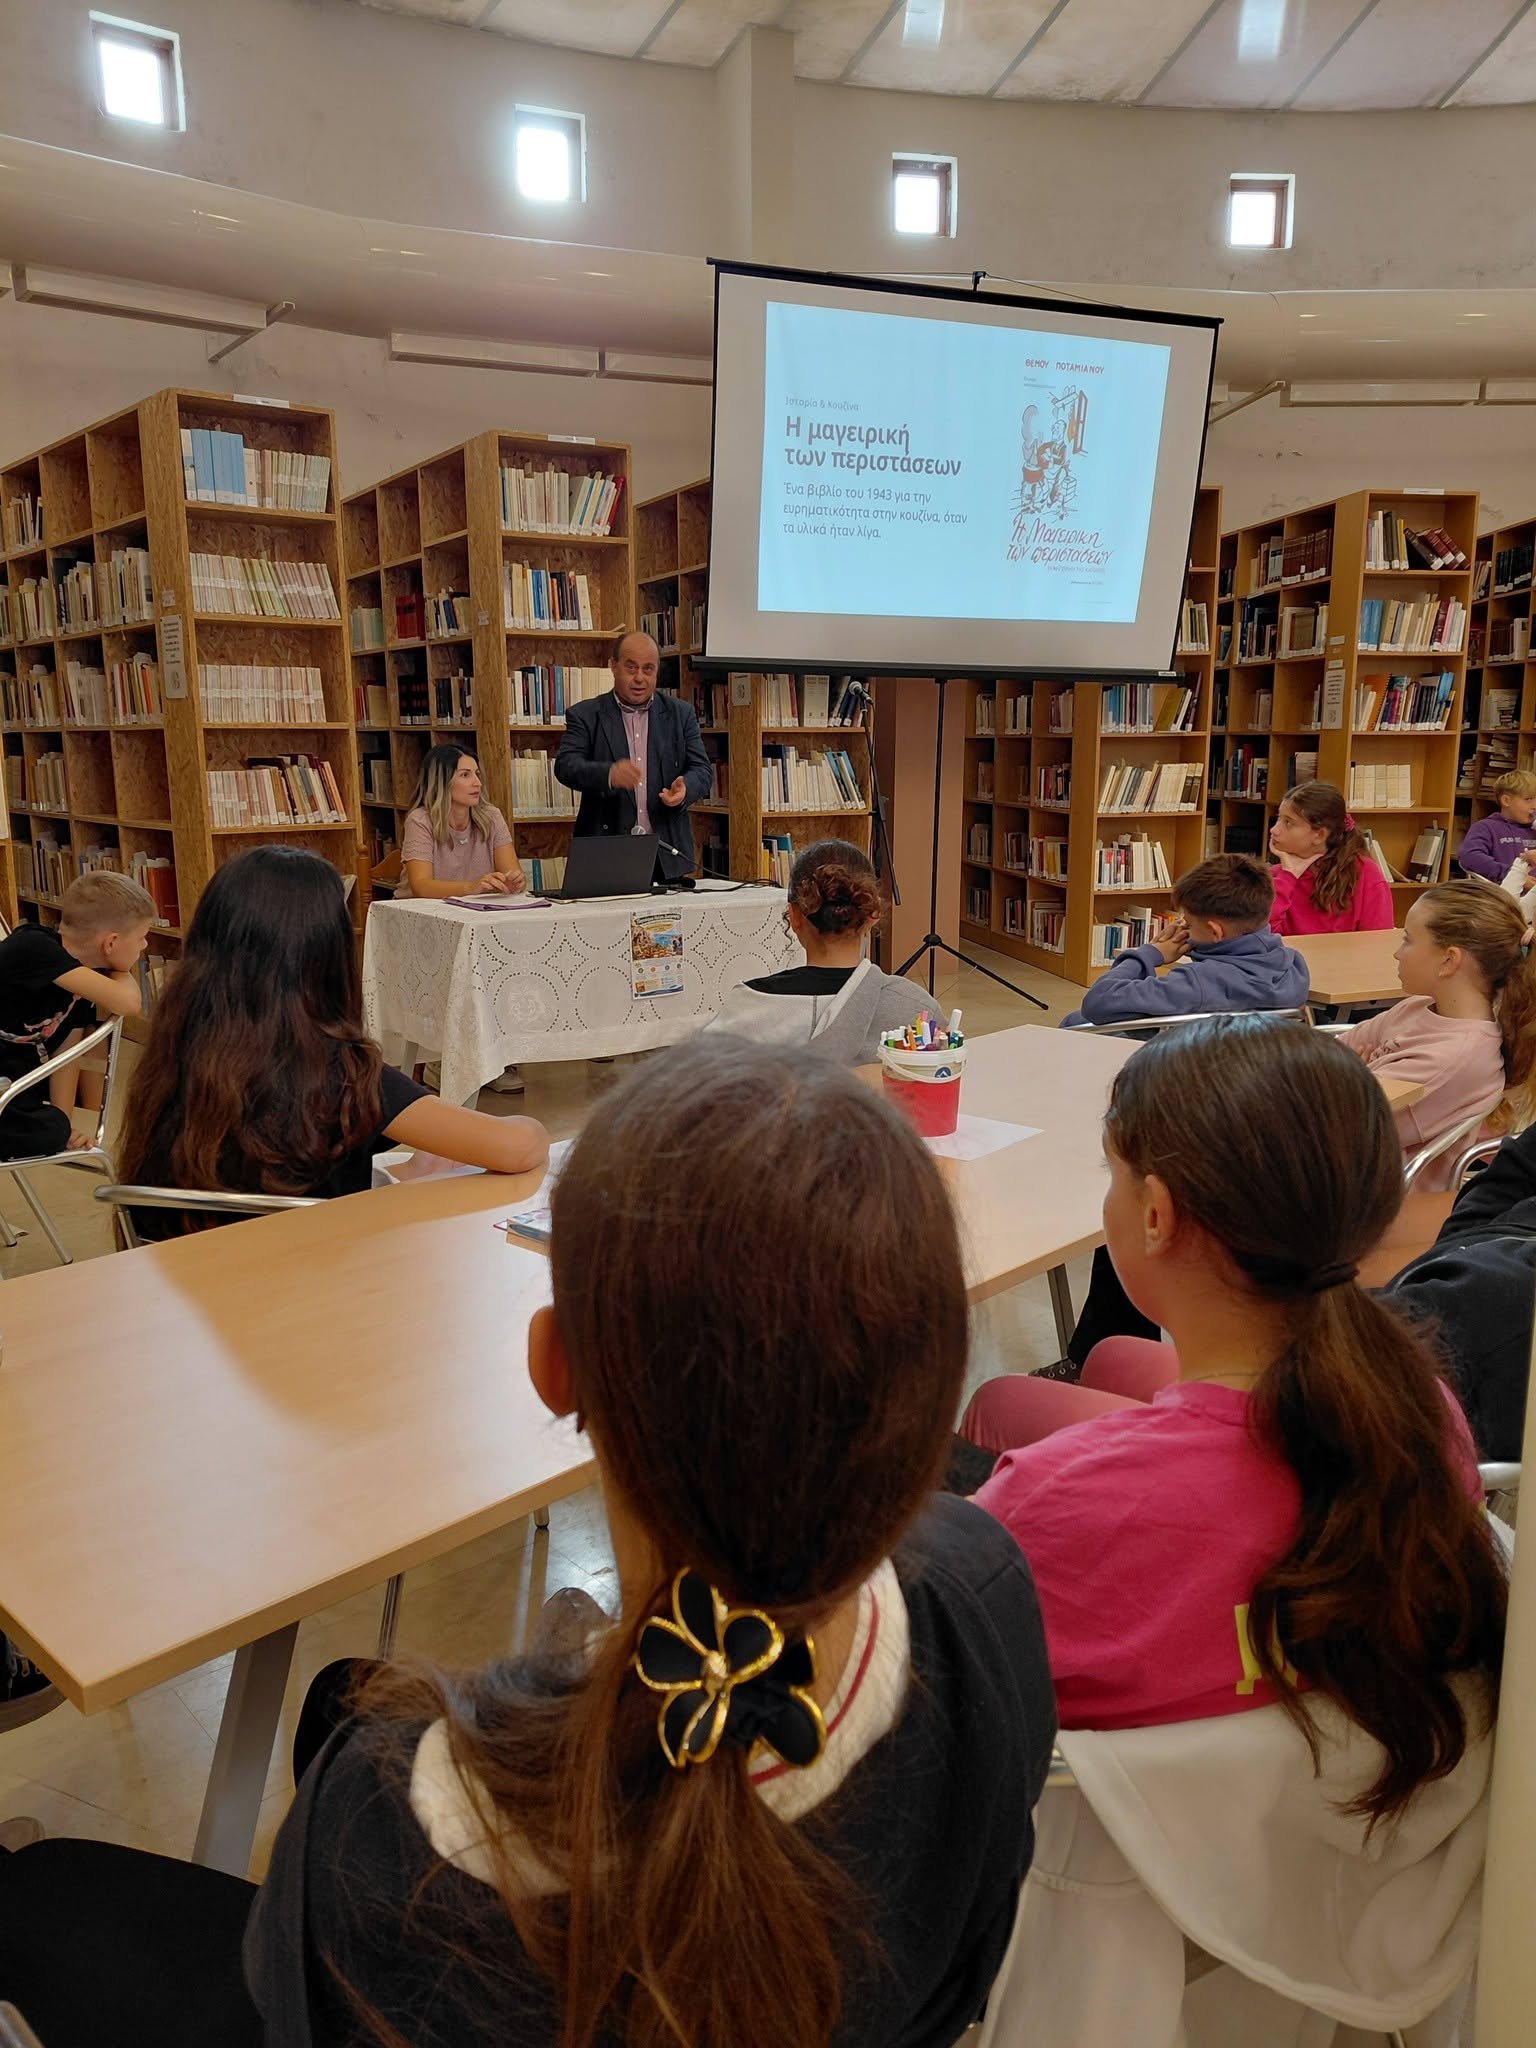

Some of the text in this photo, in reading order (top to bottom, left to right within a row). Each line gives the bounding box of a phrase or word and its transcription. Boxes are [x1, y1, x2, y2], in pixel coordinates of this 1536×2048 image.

[1025, 358, 1105, 374] ΘΕΜΟΥ ΠΟΤΑΜΙΑΝΟΥ
[820, 400, 826, 408] &
[786, 416, 910, 452] Η μαγειρική
[785, 448, 961, 475] των περιστάσεων
[784, 482, 931, 506] Ένα βιβλίο του 1943 για την
[783, 503, 968, 524] ευρηματικότητα στην κουζίνα, όταν
[783, 523, 795, 534] τα
[797, 522, 827, 536] υλικά
[830, 523, 855, 539] ήταν
